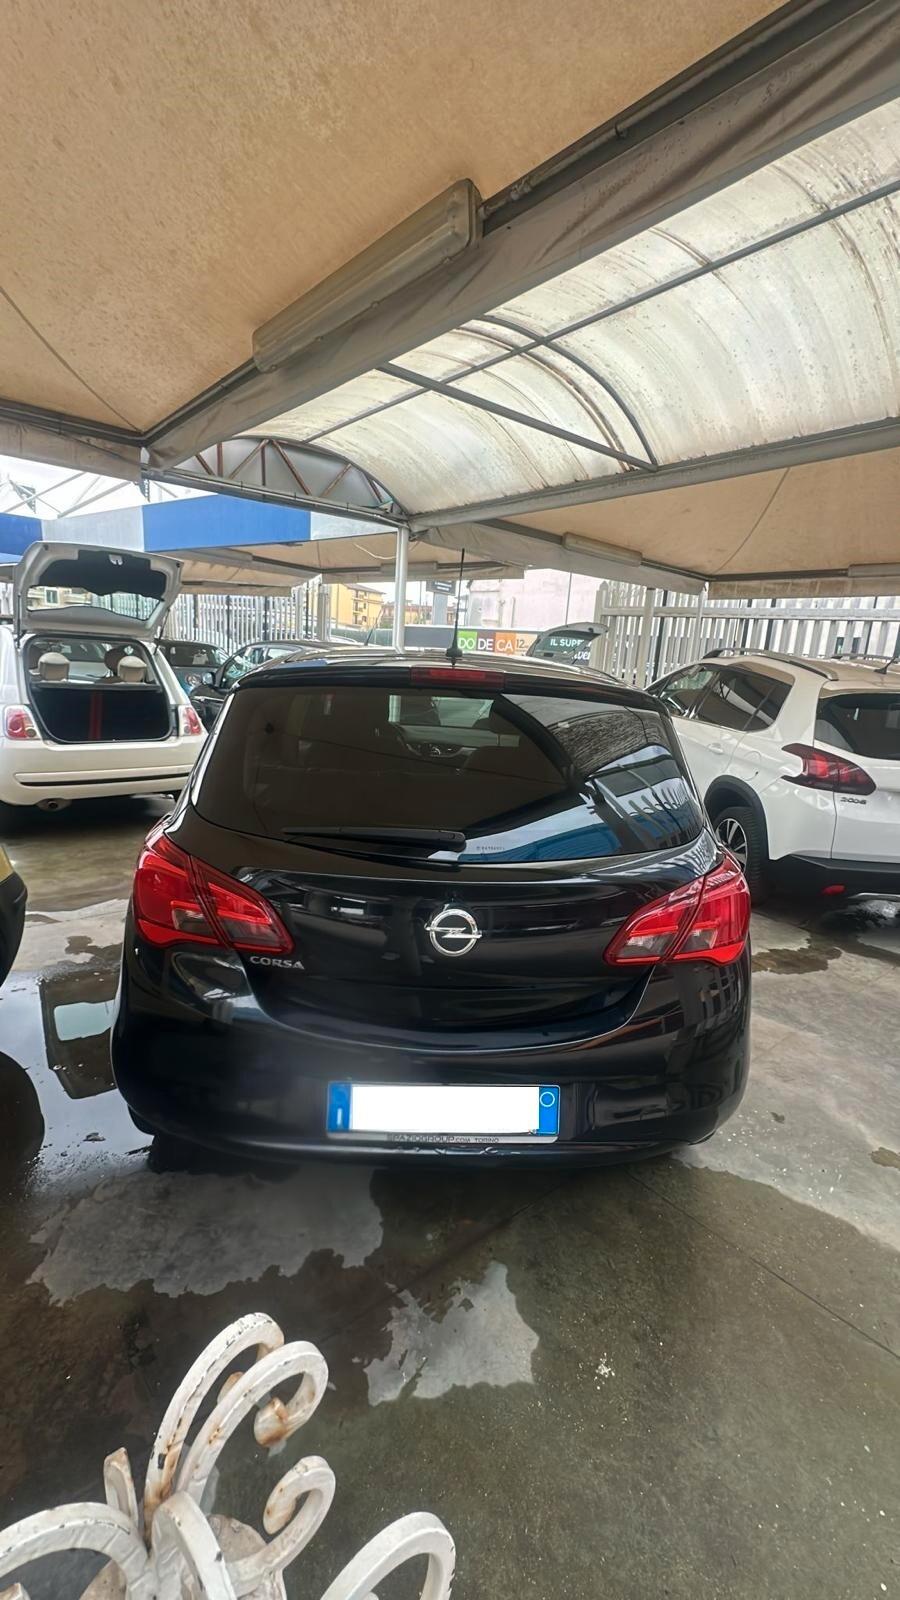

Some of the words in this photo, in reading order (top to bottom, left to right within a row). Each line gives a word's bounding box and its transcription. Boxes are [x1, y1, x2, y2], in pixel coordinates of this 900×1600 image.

[478, 638, 494, 651] DE
[496, 640, 514, 652] CA
[550, 638, 558, 647] IL
[250, 956, 305, 970] CORSA
